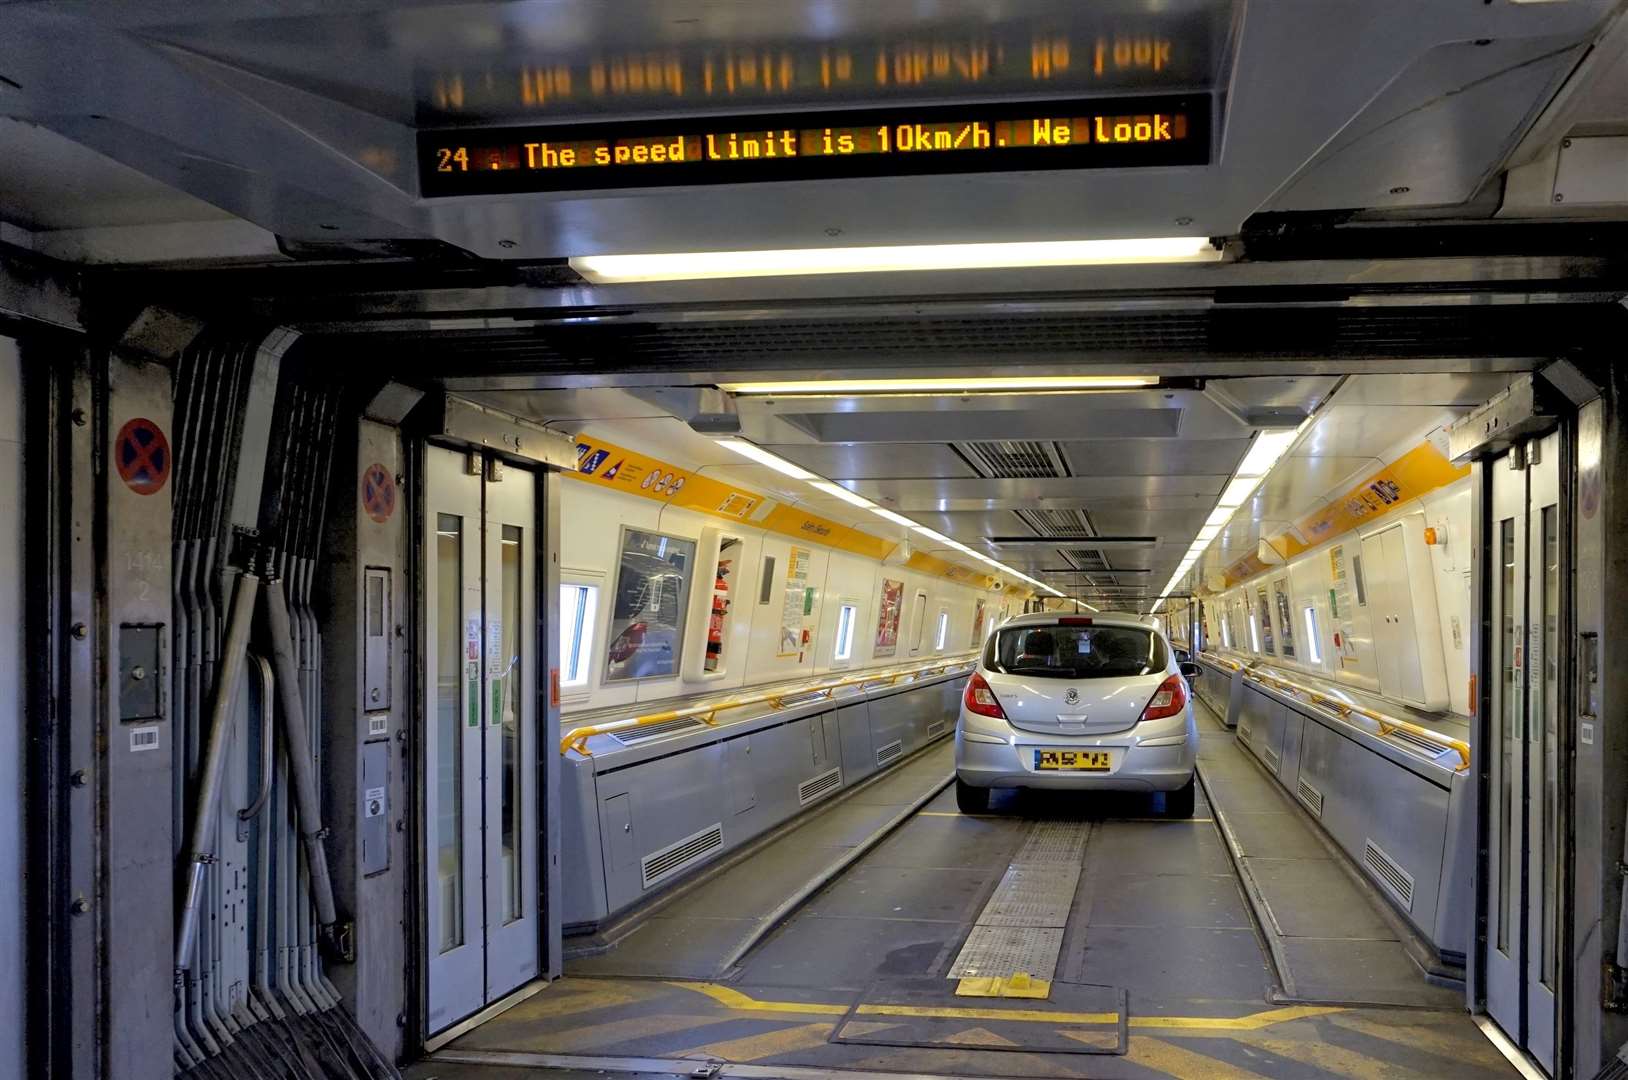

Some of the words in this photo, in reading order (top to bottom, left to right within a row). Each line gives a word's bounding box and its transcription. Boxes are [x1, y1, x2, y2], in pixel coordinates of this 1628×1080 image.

[437, 147, 469, 172] 24
[524, 142, 576, 168] The
[594, 135, 685, 165] speed
[706, 130, 797, 159] limit
[823, 128, 855, 155] is
[877, 122, 1006, 152] 10km/h.
[1033, 118, 1071, 144] We
[1094, 114, 1171, 143] look
